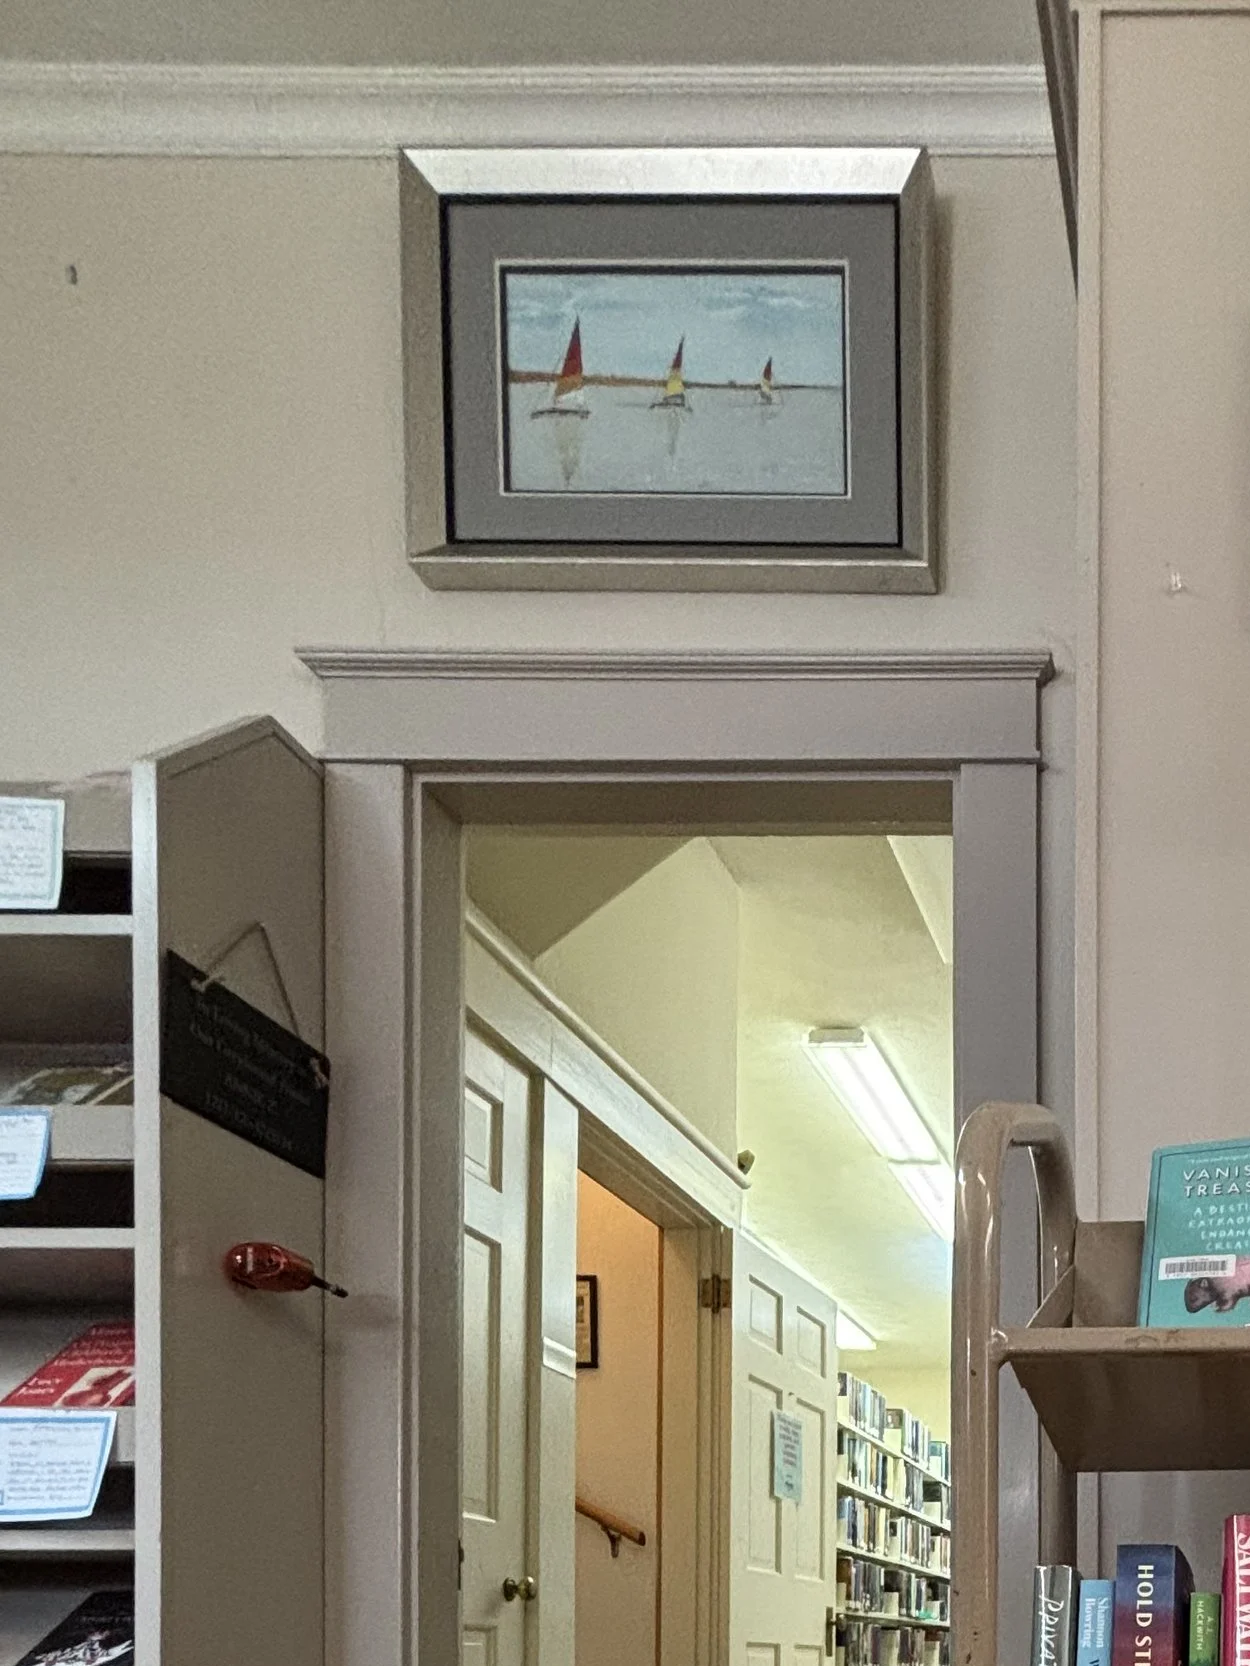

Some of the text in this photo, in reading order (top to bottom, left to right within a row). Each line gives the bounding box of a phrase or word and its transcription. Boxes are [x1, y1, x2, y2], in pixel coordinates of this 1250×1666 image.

[1136, 1564, 1154, 1628] HOLD
[1082, 1598, 1096, 1649] Bowring
[1096, 1597, 1108, 1648] Shannon
[1196, 1600, 1204, 1650] HACKWITH
